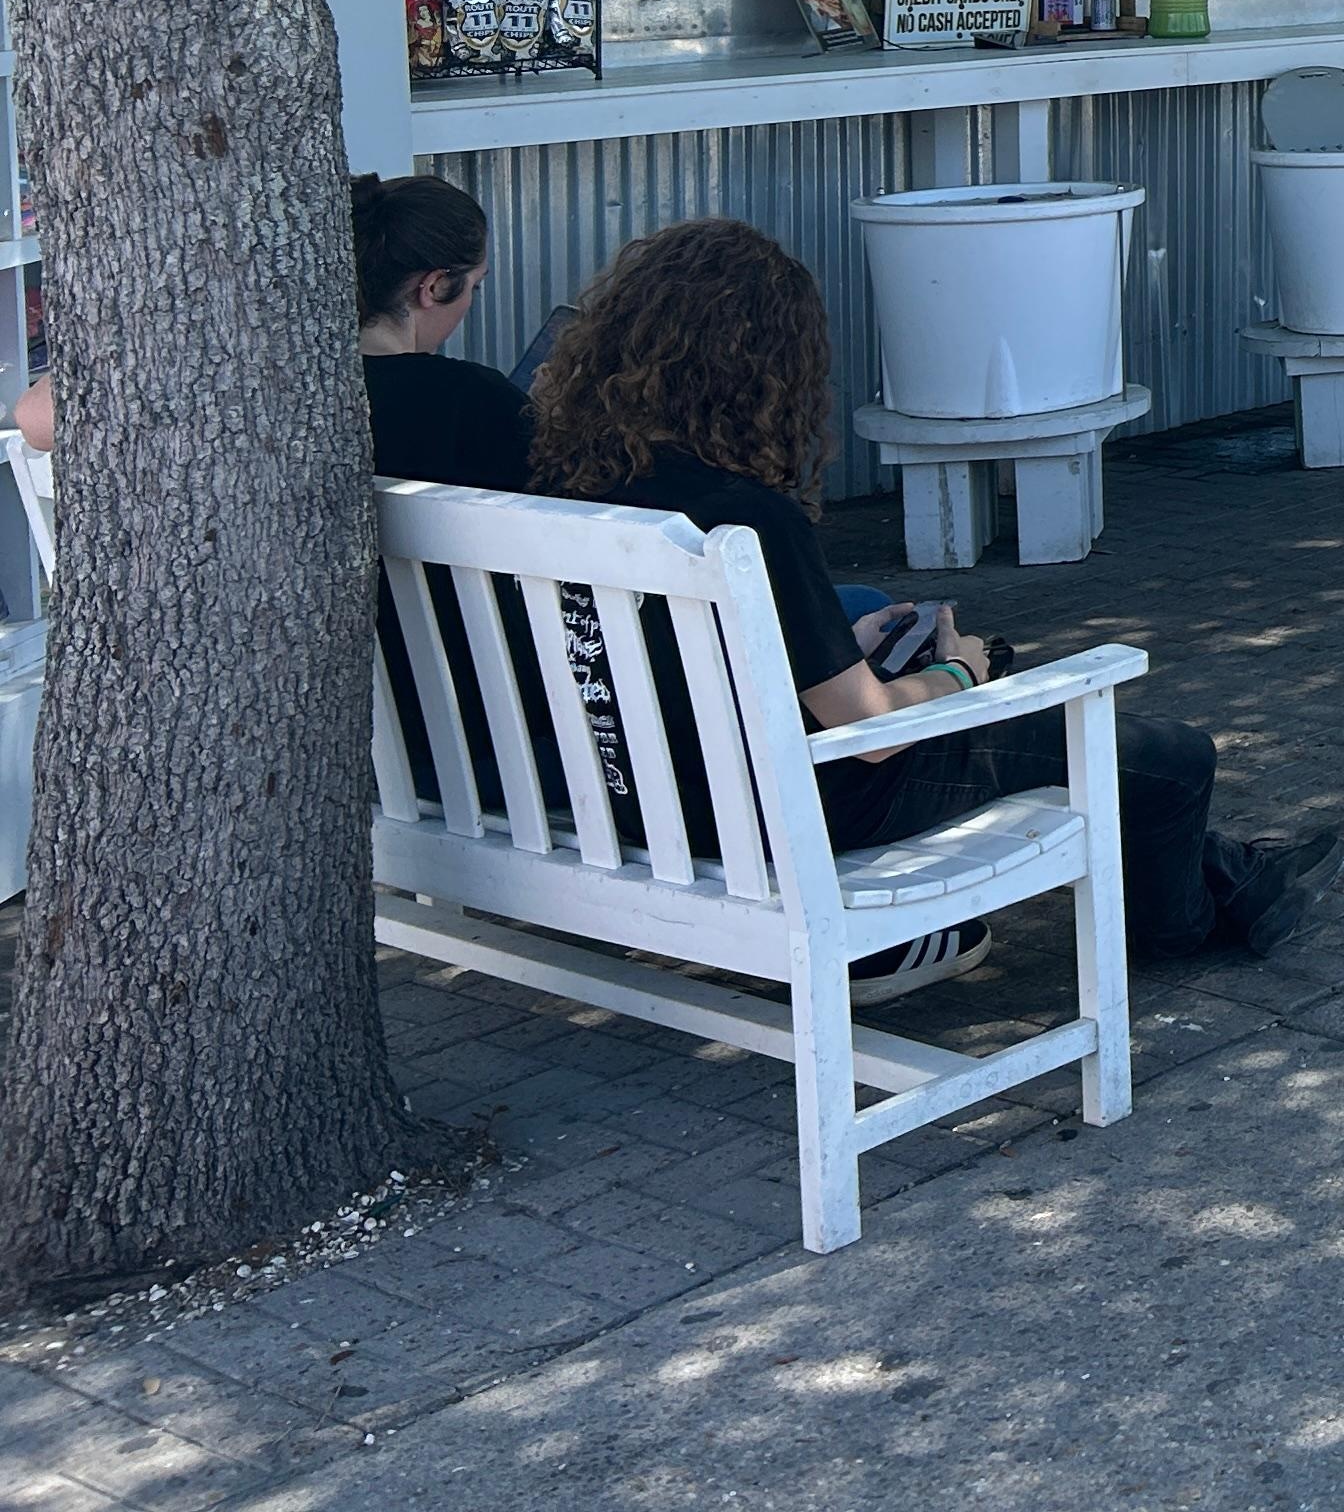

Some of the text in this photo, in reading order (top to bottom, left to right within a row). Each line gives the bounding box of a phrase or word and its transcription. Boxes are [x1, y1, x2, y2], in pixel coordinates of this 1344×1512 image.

[505, 4, 538, 13] ROUTE
[572, 3, 590, 16] 11
[469, 13, 492, 26] 11
[508, 15, 533, 28] 11
[896, 9, 1021, 34] NO CASH ACCEPTED
